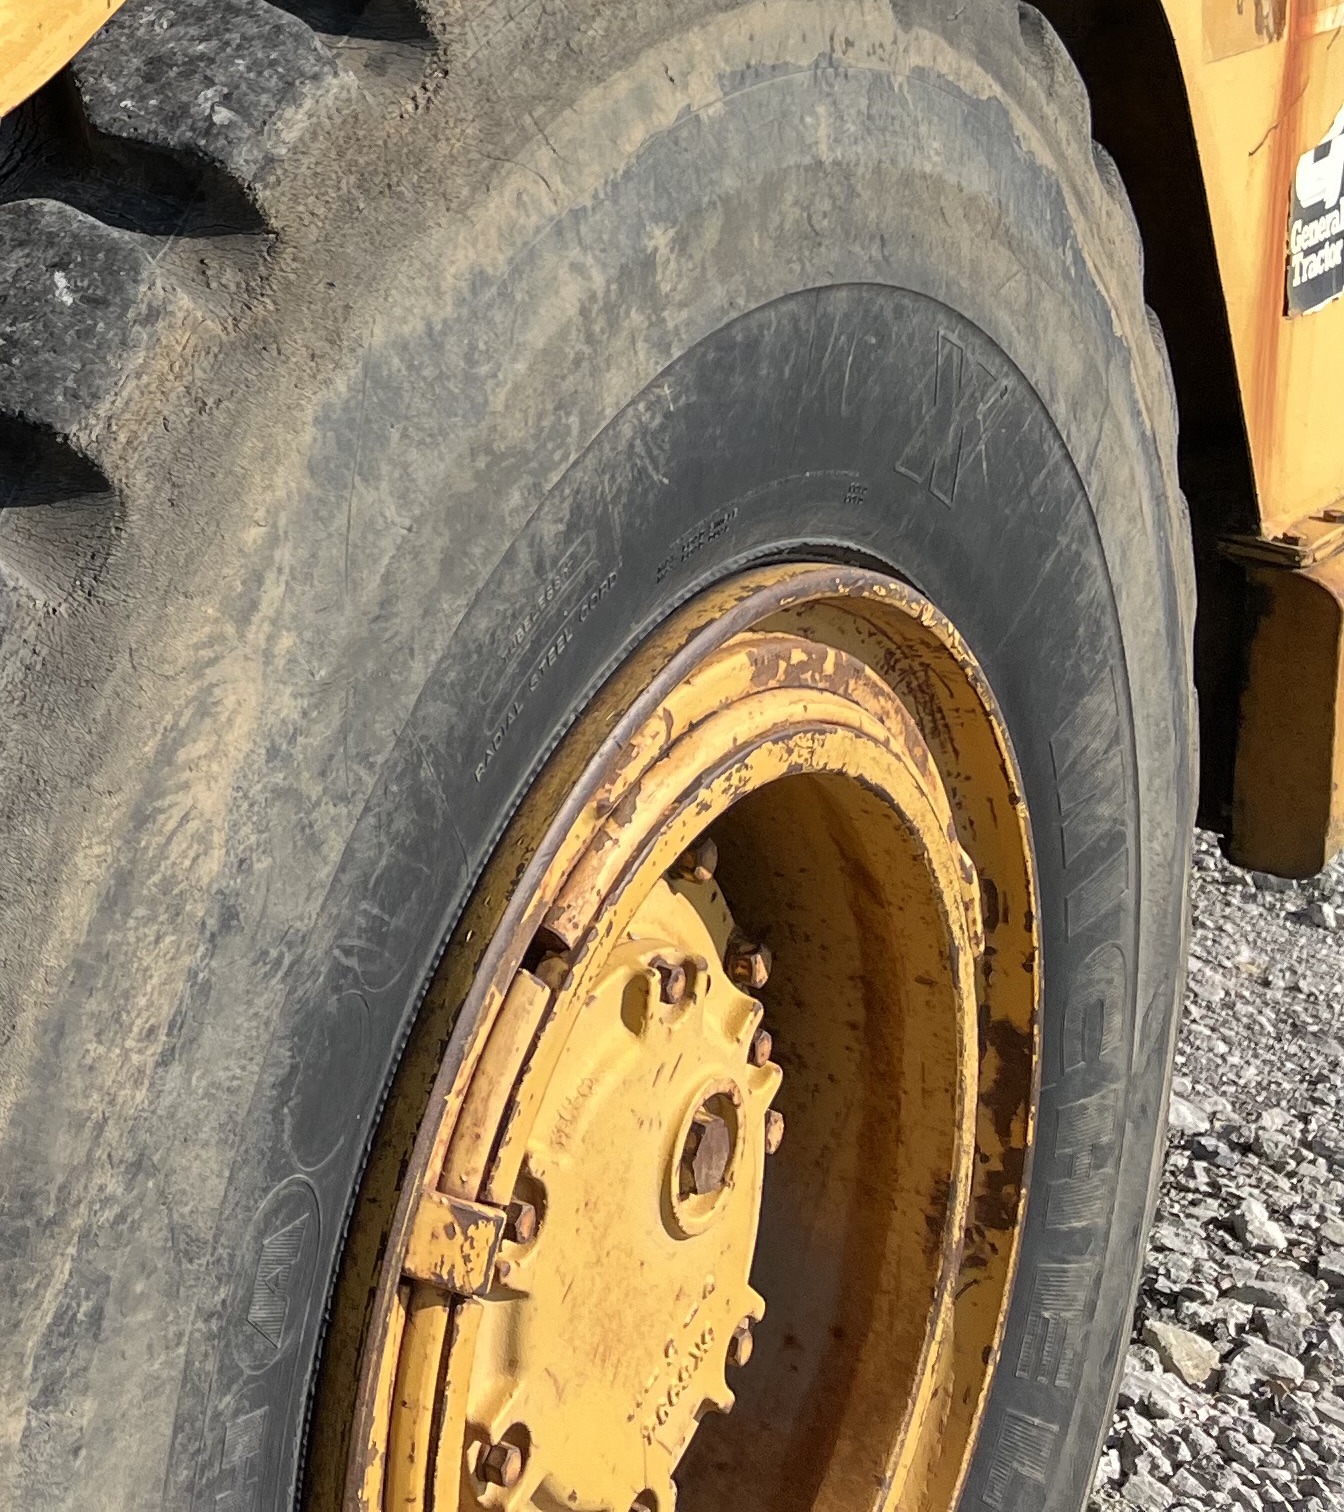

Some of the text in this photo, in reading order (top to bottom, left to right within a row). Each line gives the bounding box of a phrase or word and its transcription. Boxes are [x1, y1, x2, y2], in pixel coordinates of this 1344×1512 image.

[1291, 196, 1344, 255] General
[1292, 239, 1344, 288] Tractor
[473, 571, 618, 785] RADIAL STEEL CORD
